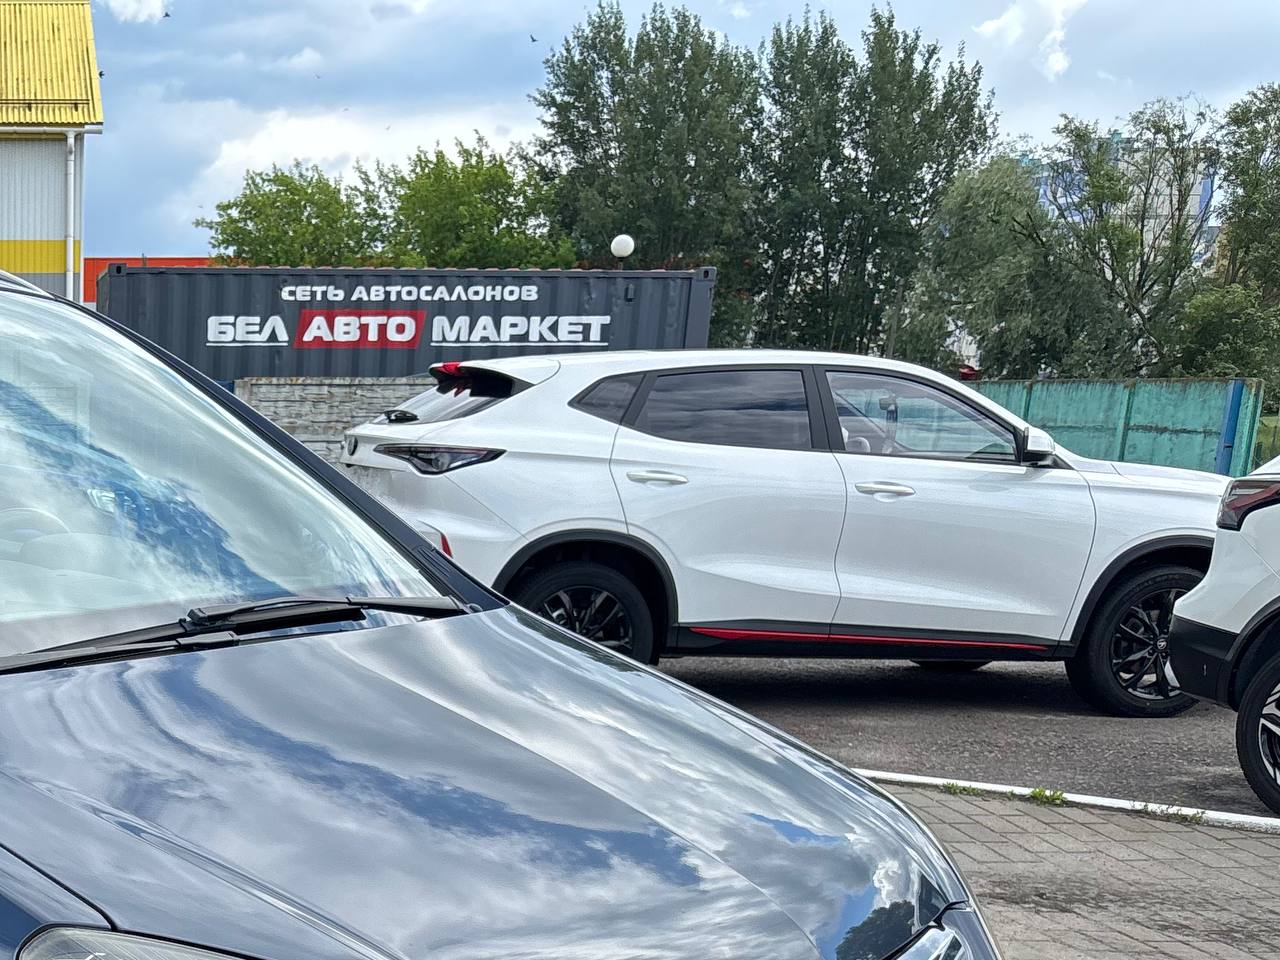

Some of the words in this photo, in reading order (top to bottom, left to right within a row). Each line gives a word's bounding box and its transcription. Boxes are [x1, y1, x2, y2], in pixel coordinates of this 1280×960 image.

[281, 285, 345, 301] СЕТЬ
[351, 285, 539, 301] АВТОСАЛОНОВ
[207, 316, 288, 343] БЕЛ
[303, 316, 417, 343] АВТО
[432, 316, 611, 343] МАРКЕТ
